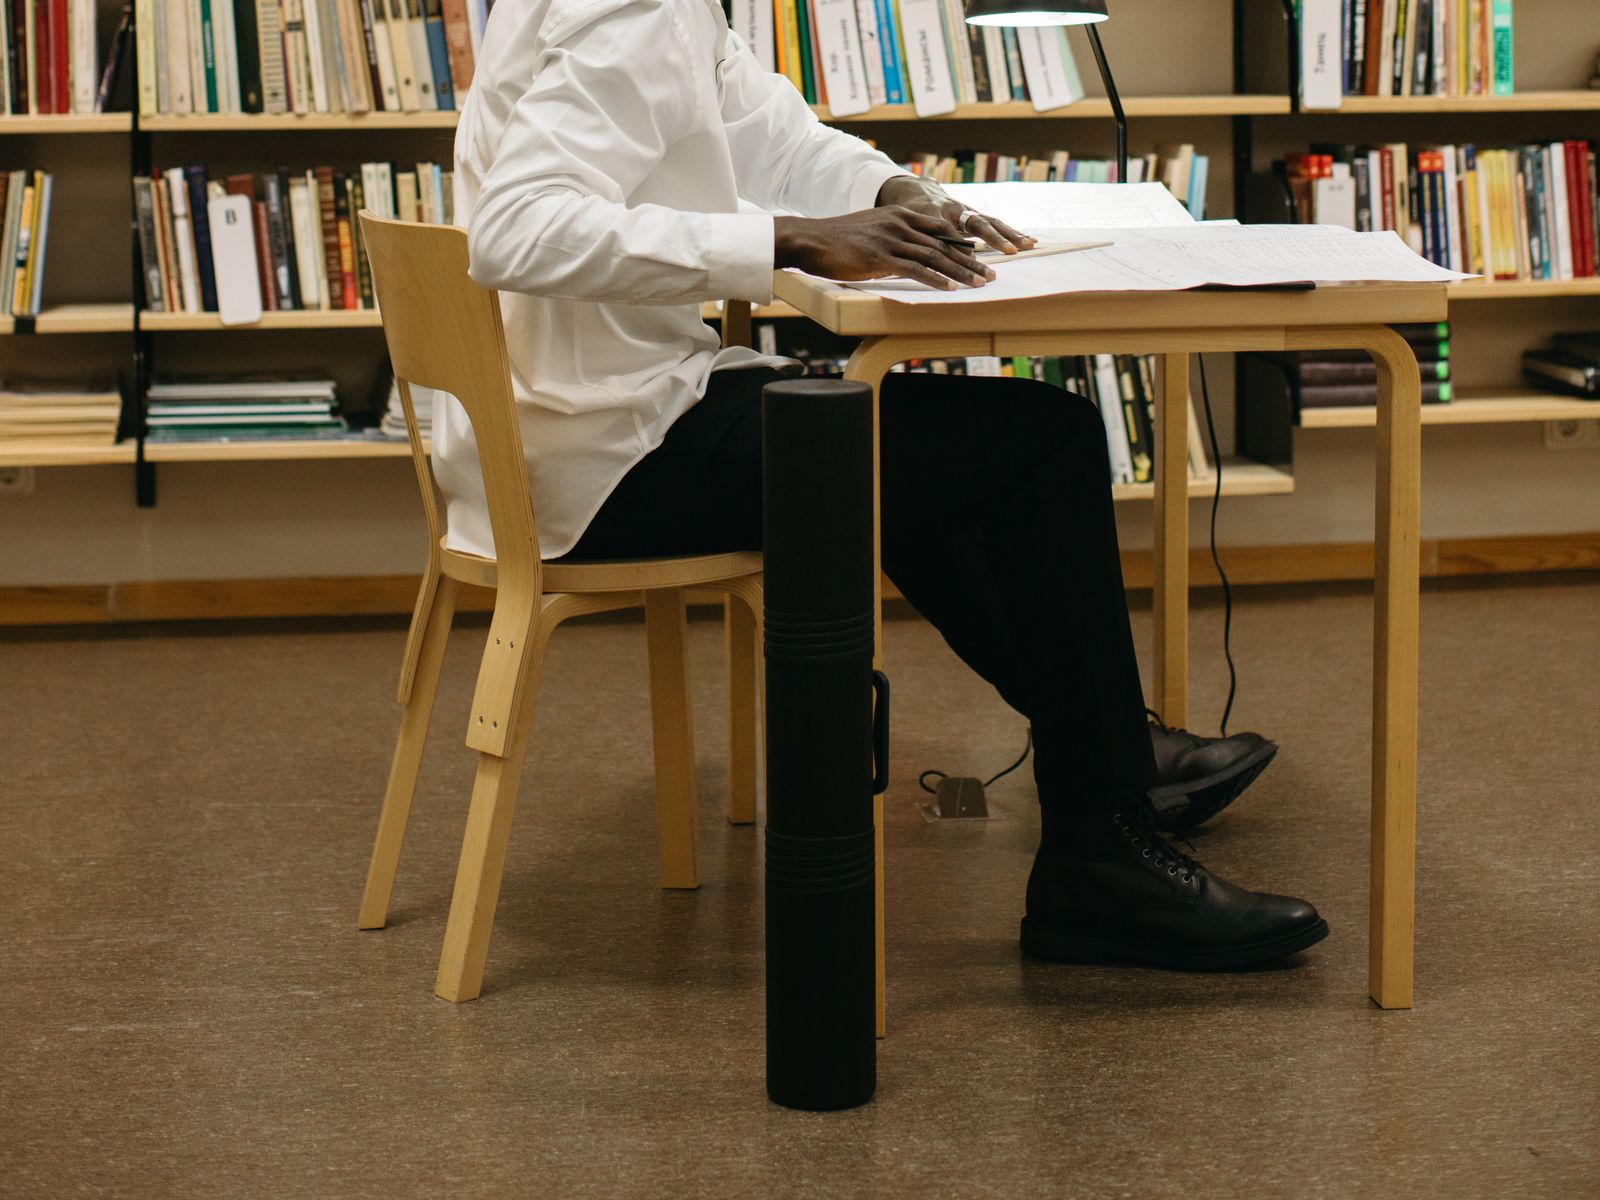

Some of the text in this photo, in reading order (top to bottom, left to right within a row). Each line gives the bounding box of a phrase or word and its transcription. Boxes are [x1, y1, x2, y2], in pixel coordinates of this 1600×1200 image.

[918, 29, 936, 93] Романсы
[1313, 32, 1327, 74] Танец
[224, 209, 237, 225] В
